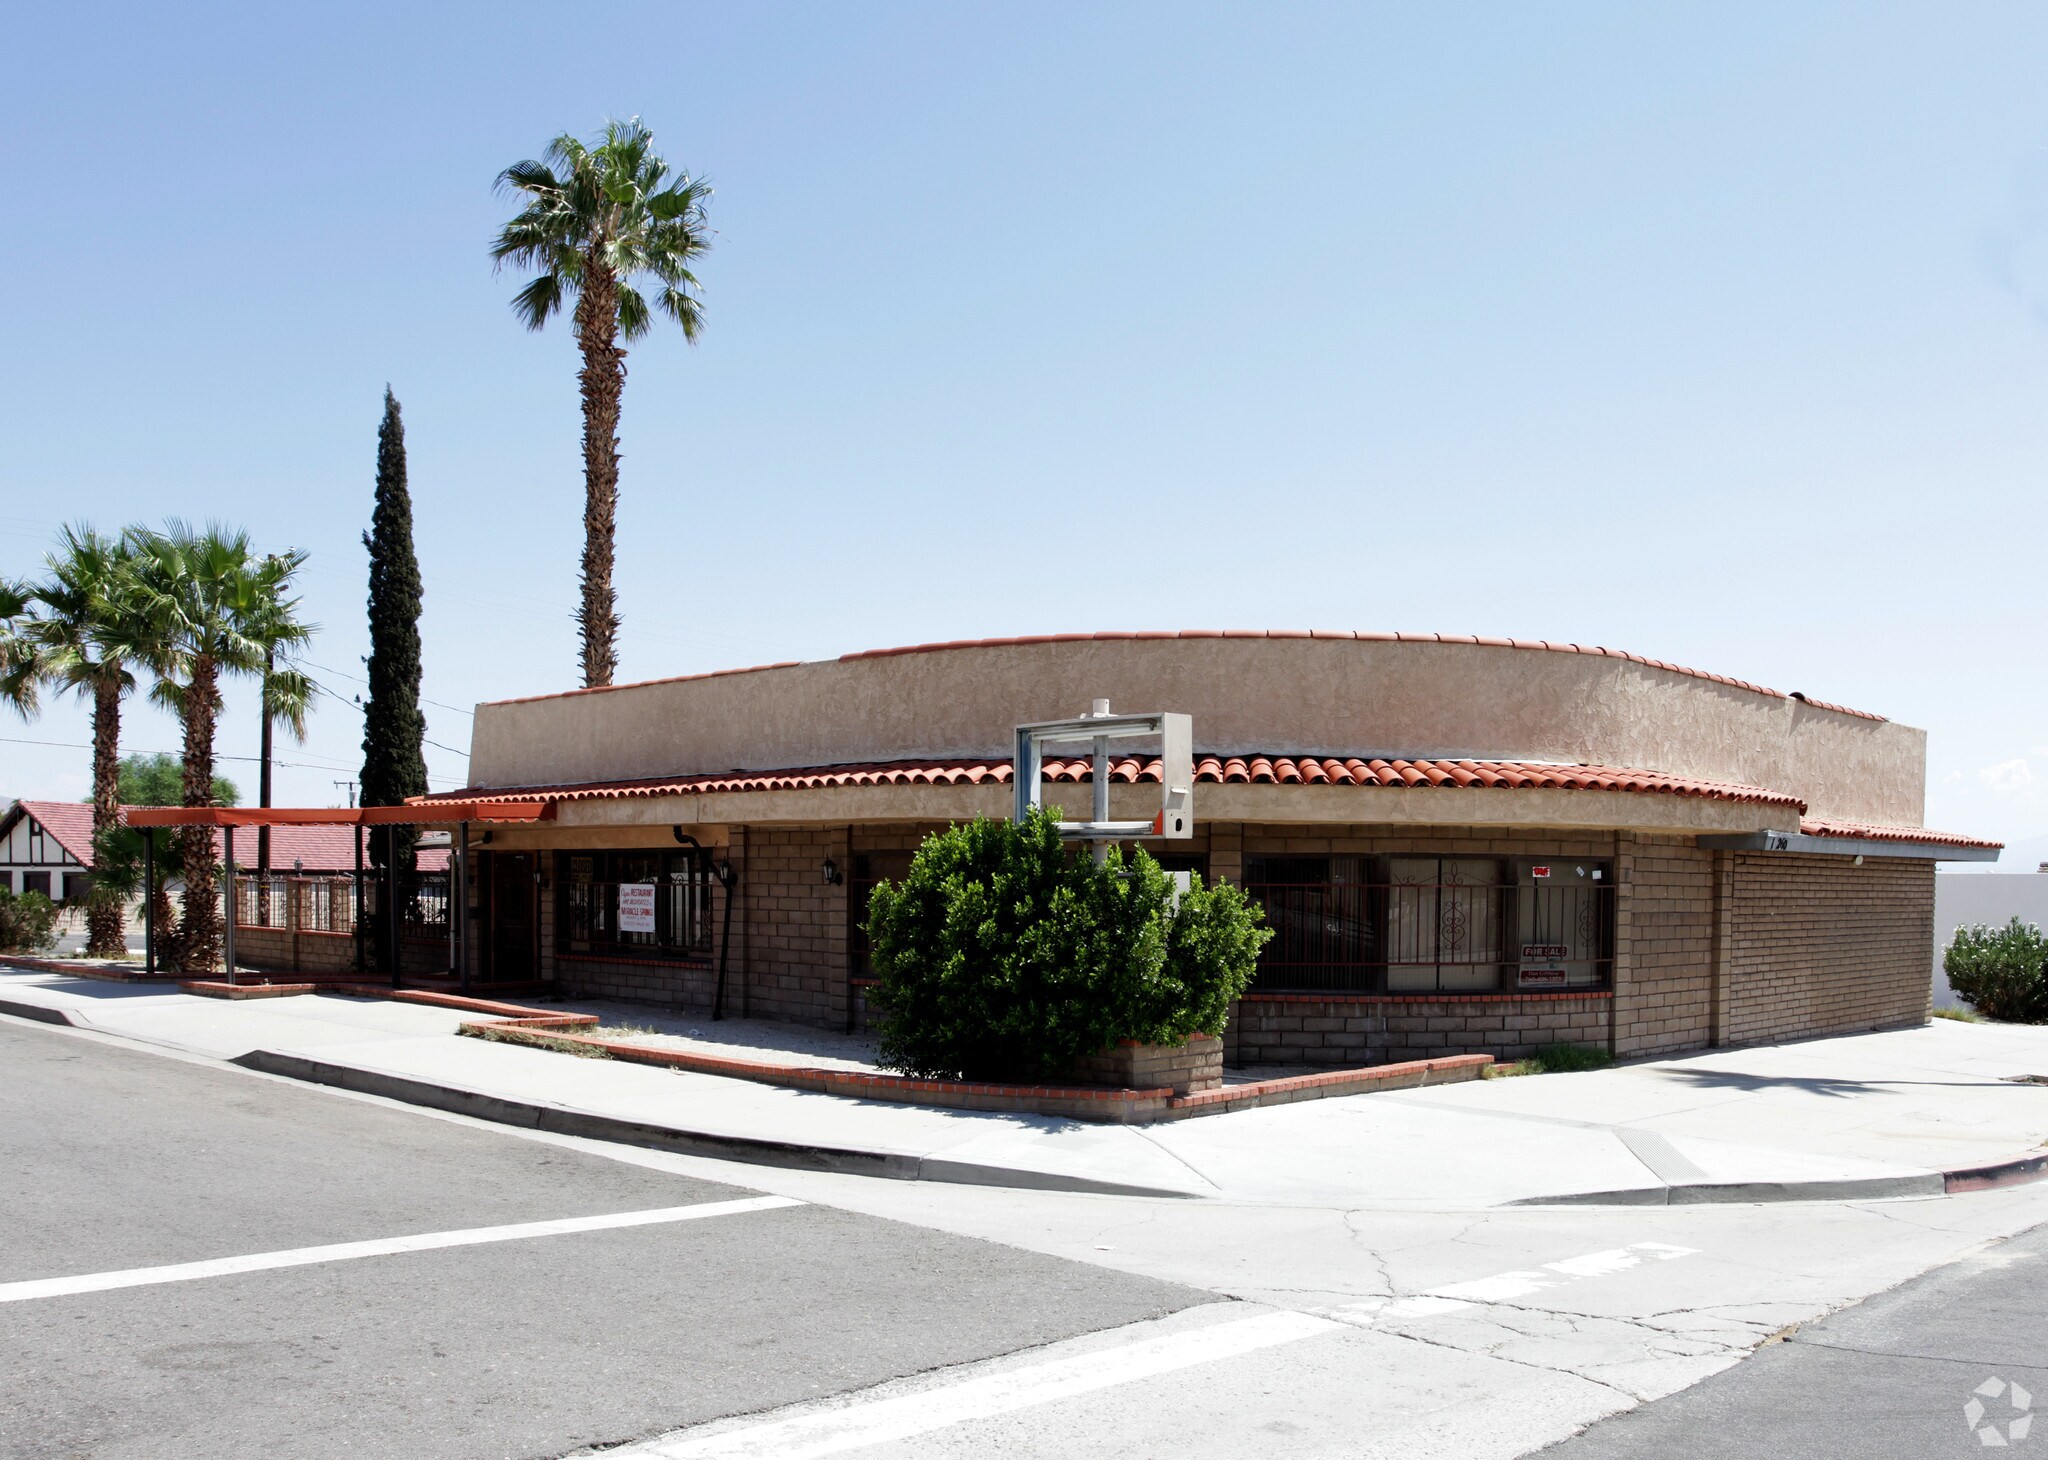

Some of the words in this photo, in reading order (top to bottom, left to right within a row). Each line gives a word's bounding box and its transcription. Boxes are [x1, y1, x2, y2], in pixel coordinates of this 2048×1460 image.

[571, 858, 593, 873] CLOSED
[630, 888, 654, 897] RESTAURANT
[1525, 948, 1542, 956] FOR
[1544, 948, 1566, 956] SALE
